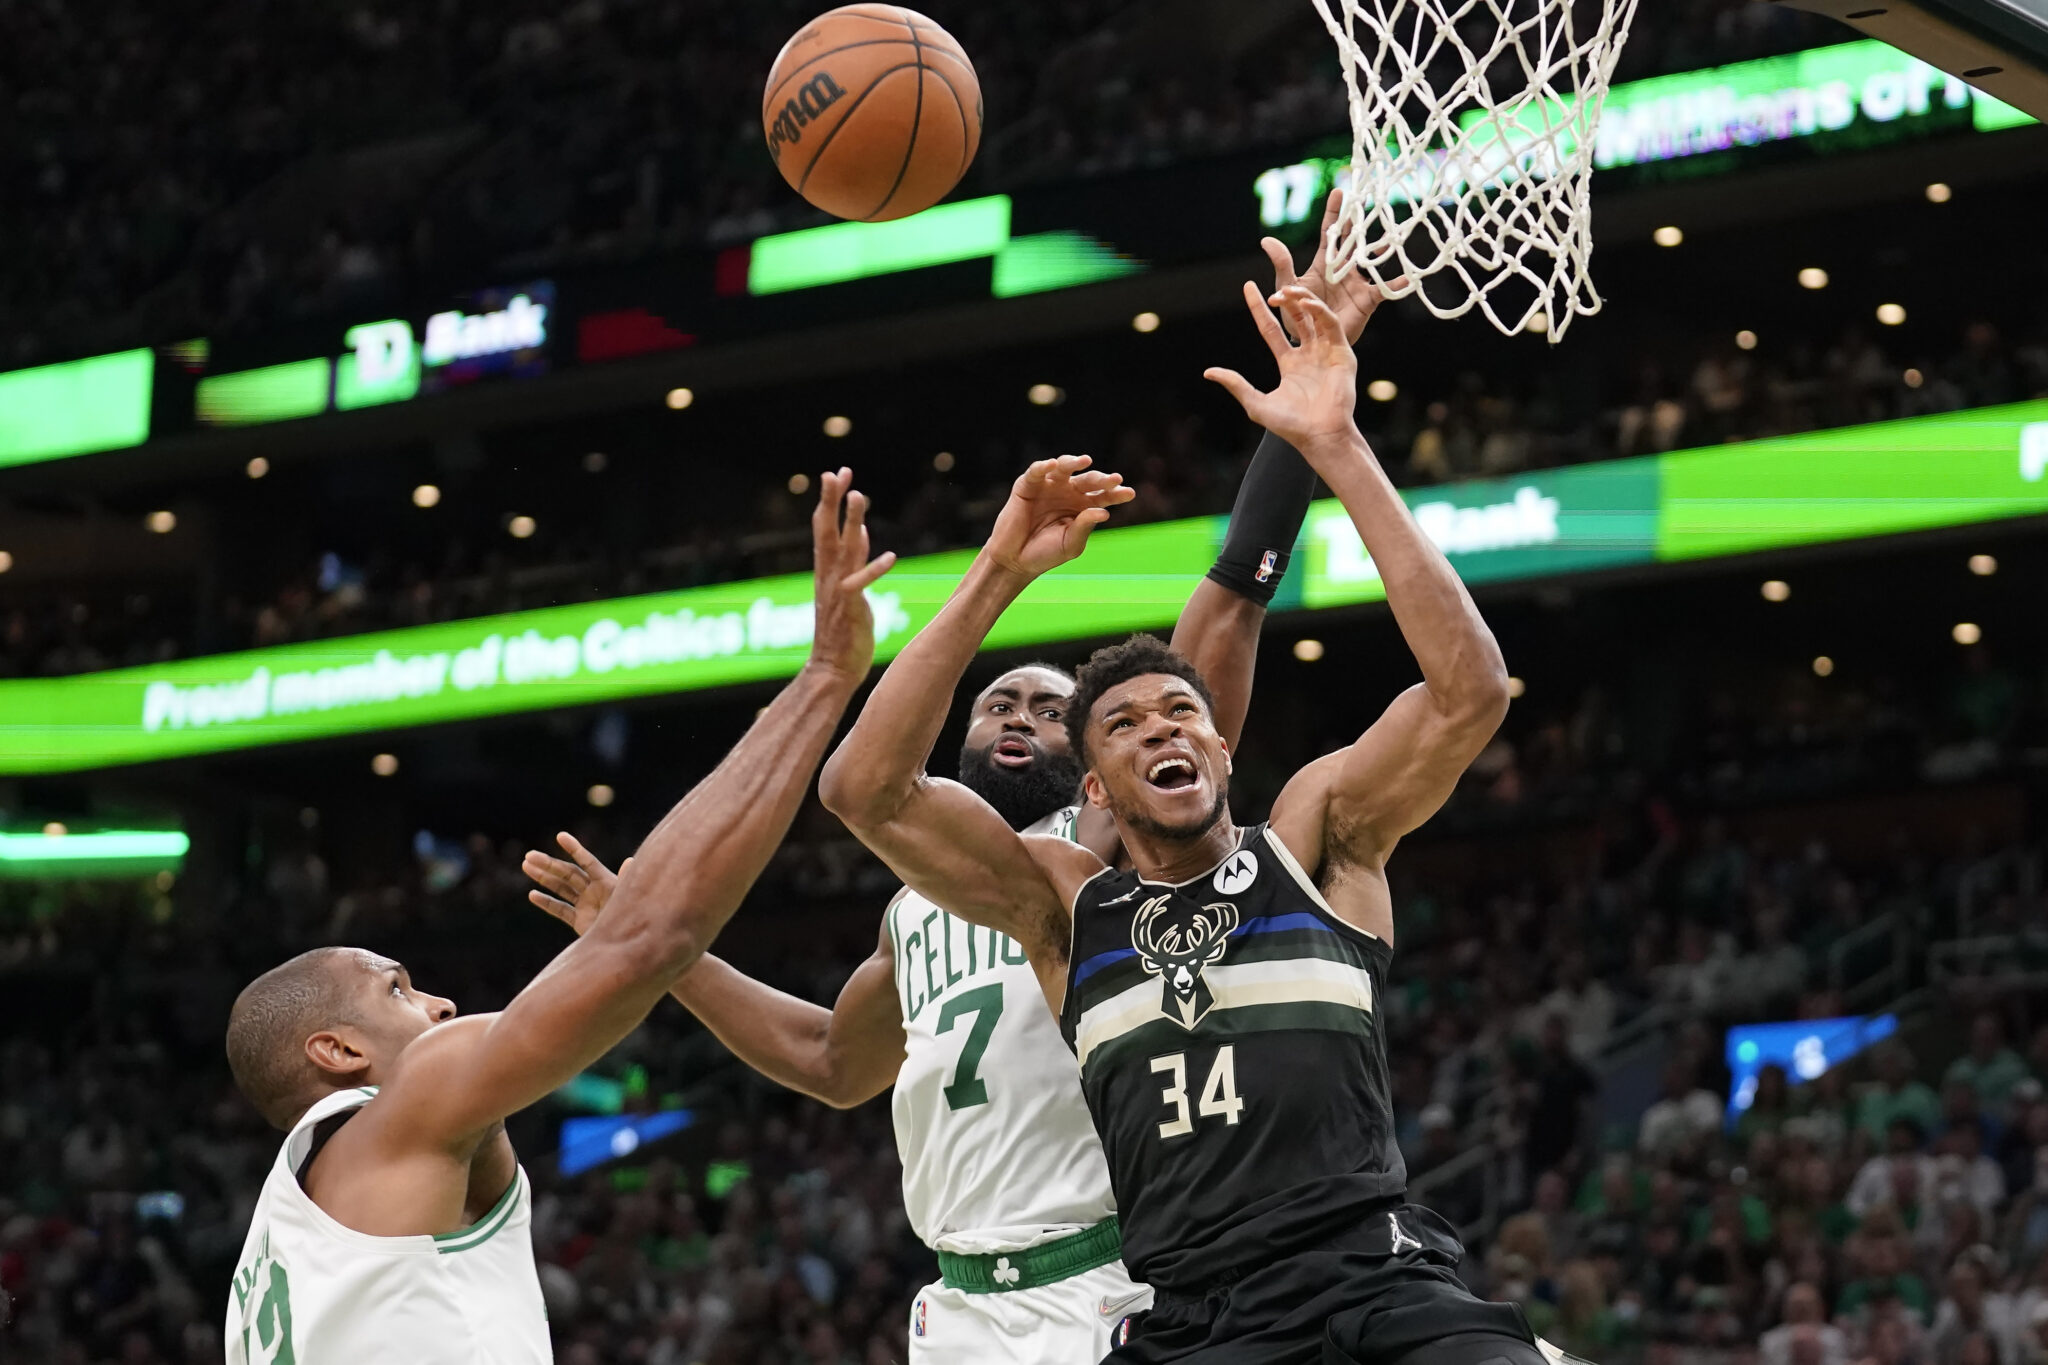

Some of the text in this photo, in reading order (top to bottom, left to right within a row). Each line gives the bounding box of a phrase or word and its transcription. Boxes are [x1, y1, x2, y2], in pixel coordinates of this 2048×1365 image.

[423, 294, 548, 367] Bank
[142, 665, 270, 733] Proud
[271, 649, 449, 715] member
[452, 634, 504, 692] of
[504, 628, 581, 684] the
[581, 608, 746, 675] Celtics
[935, 982, 1004, 1111] 7
[1150, 1045, 1244, 1139] 34
